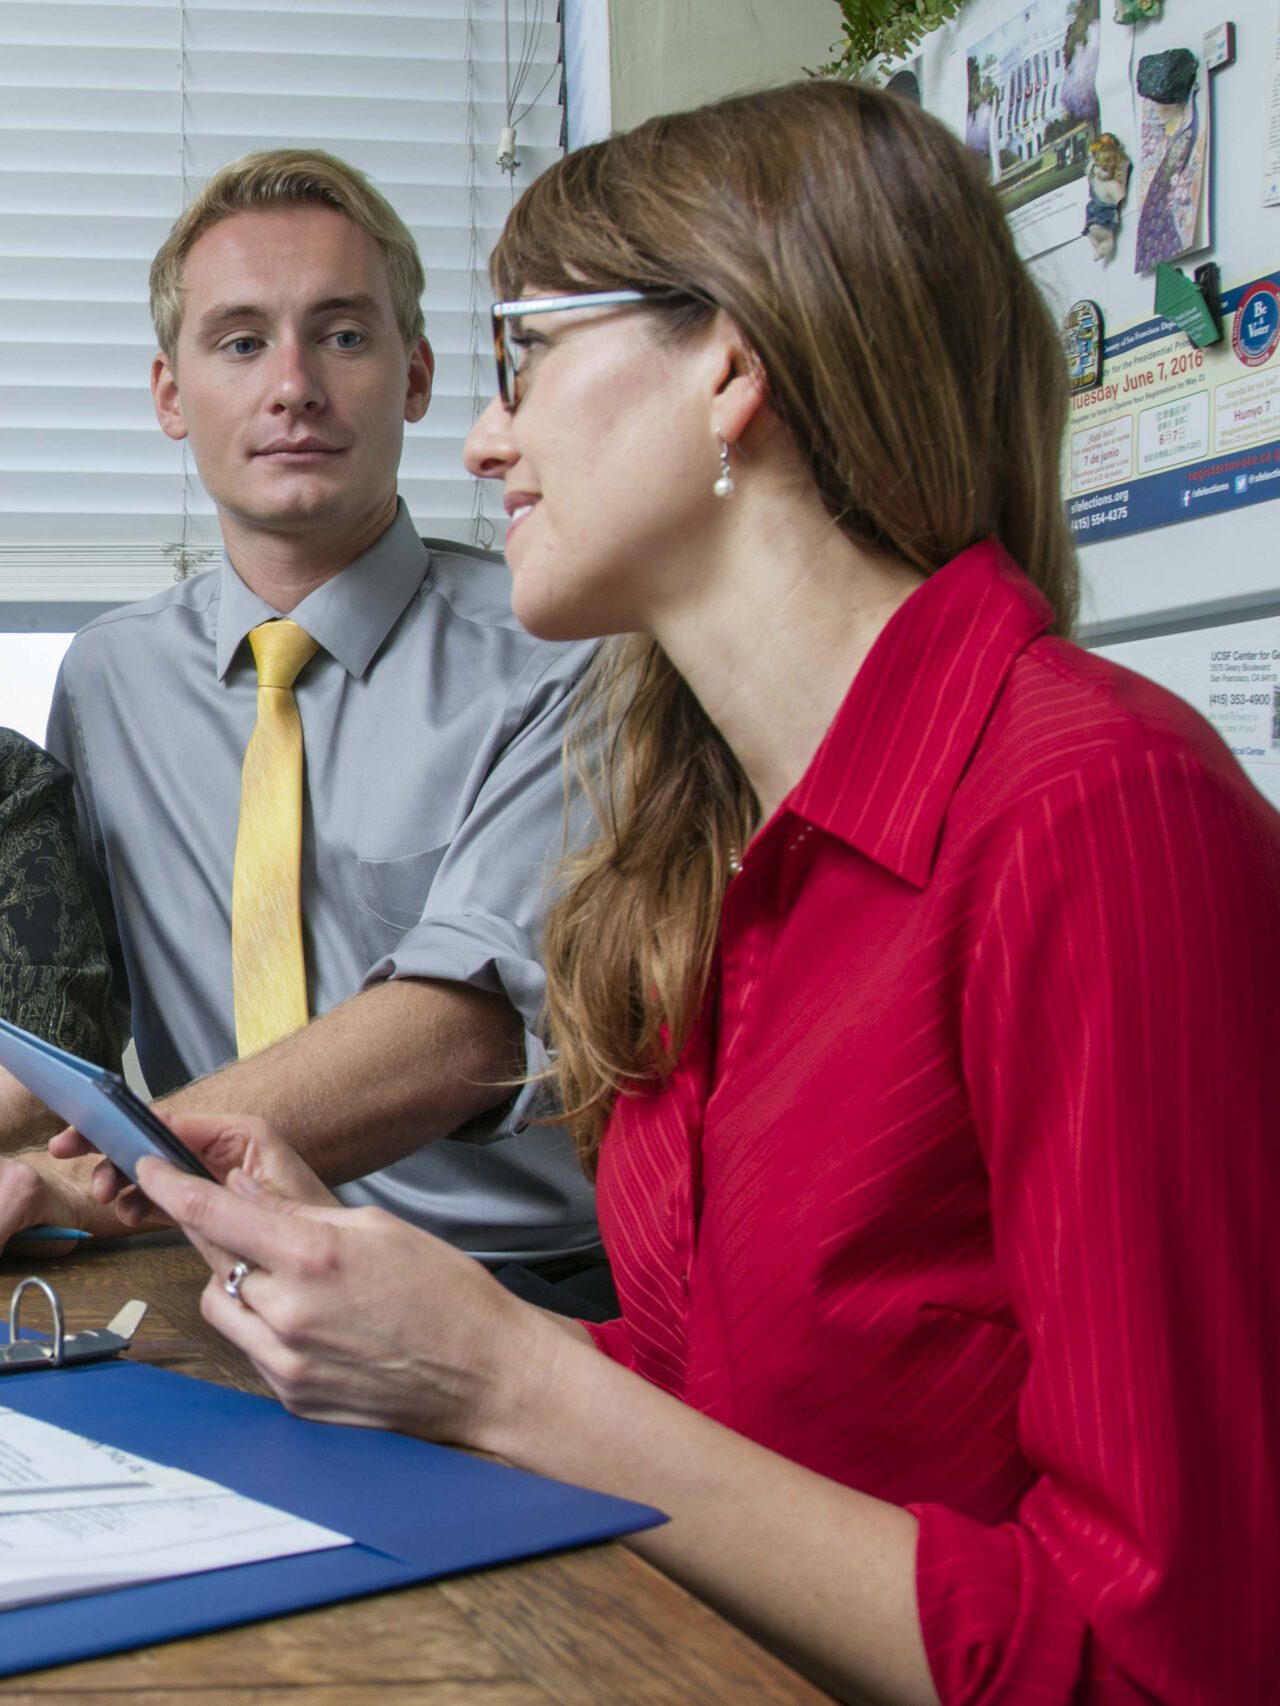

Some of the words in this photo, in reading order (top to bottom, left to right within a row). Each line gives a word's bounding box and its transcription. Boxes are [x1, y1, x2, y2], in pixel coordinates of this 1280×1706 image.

[1253, 301, 1268, 318] Be
[1248, 322, 1270, 338] Voter
[1112, 365, 1120, 373] for
[1122, 360, 1133, 370] the
[1133, 345, 1172, 362] Presidential
[1123, 370, 1154, 393] June
[1157, 362, 1168, 382] 7,
[1171, 349, 1204, 377] 2016
[1234, 407, 1262, 422] Hunyo
[1265, 400, 1270, 413] 7
[1084, 456, 1089, 466] 7
[1090, 452, 1100, 464] de
[1100, 447, 1120, 463] junio
[1071, 516, 1090, 532] (415)
[1091, 506, 1128, 527] 554-4375
[1210, 651, 1231, 660] UCSF
[1232, 650, 1258, 660] Center
[1259, 650, 1270, 660] for
[1210, 694, 1228, 707] (415)
[1230, 694, 1270, 706] 353-4900
